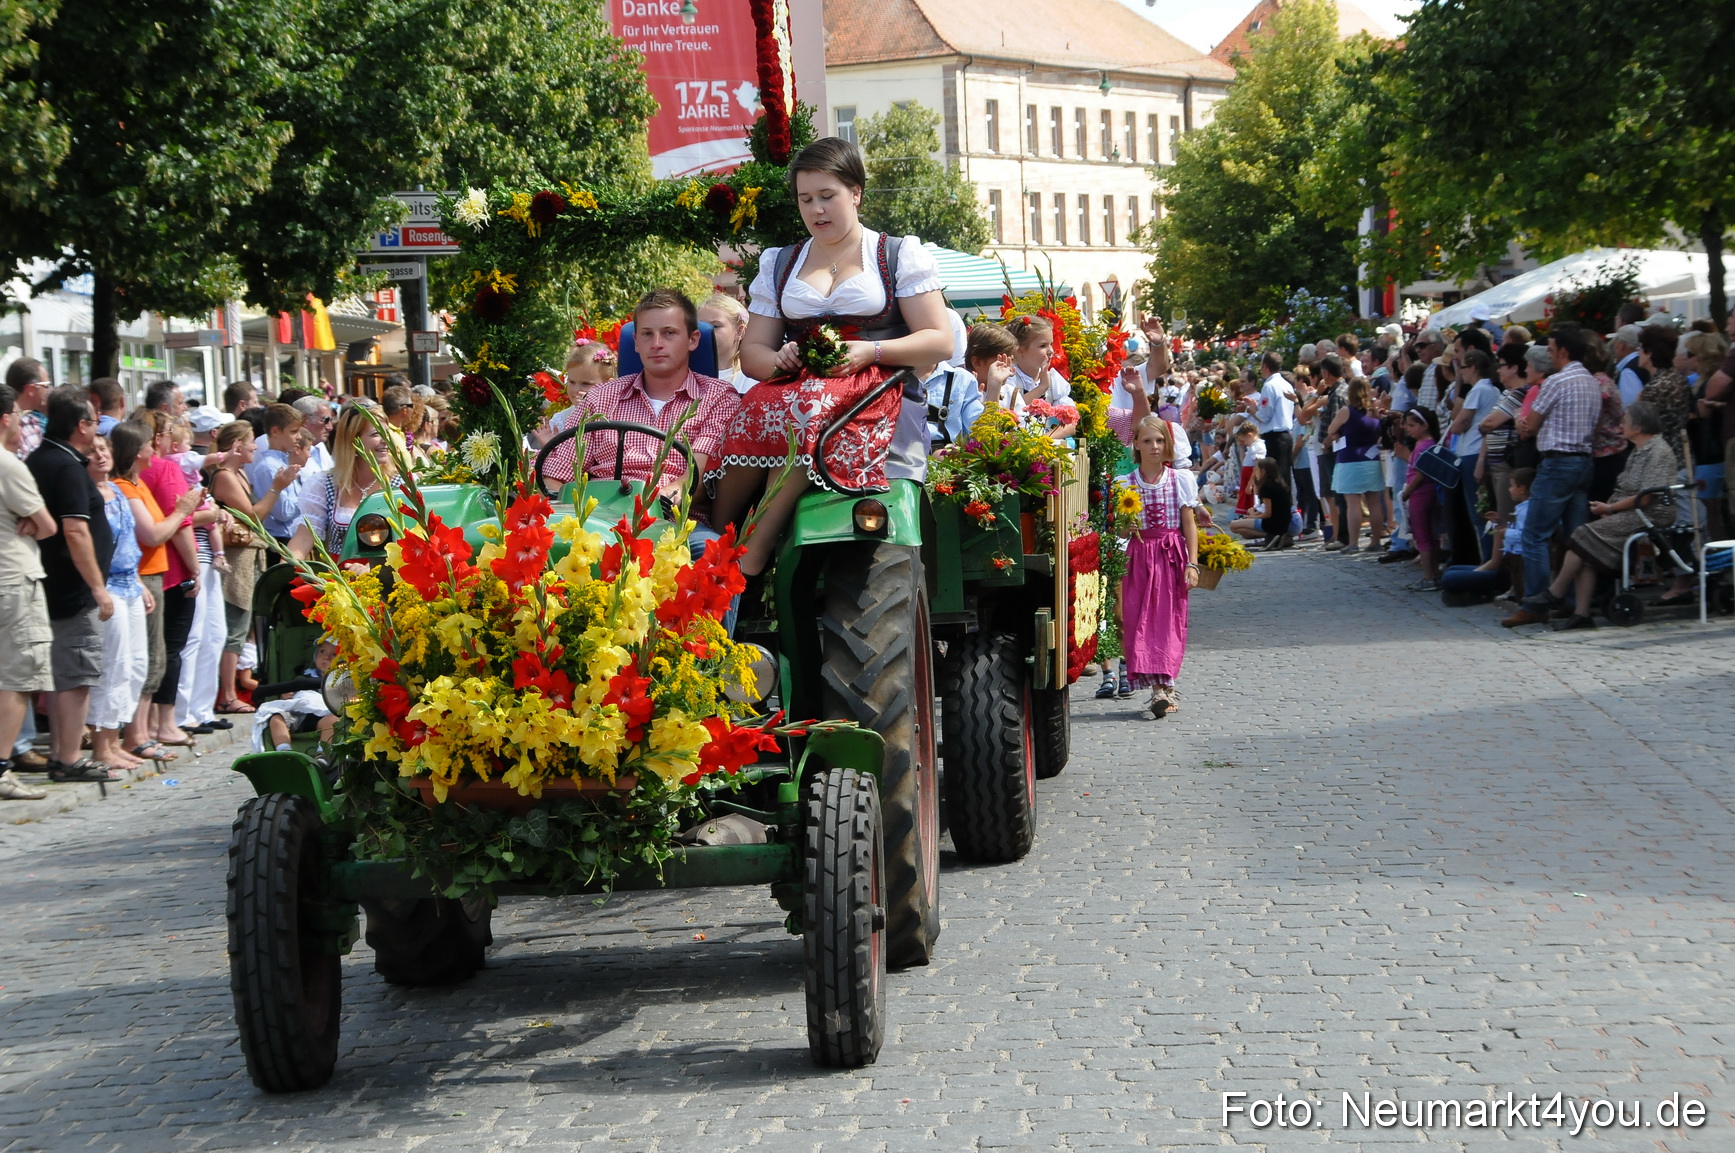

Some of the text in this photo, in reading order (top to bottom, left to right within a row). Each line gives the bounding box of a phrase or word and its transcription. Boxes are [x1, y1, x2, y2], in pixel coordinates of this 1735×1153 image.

[622, 0, 680, 16] Danke
[622, 24, 719, 37] für Ihr Vertrauen
[650, 41, 673, 52] Ihre
[675, 40, 712, 52] Treue.
[675, 81, 730, 104] 175
[678, 104, 731, 119] JAHRE
[678, 125, 709, 133] Sparkasse
